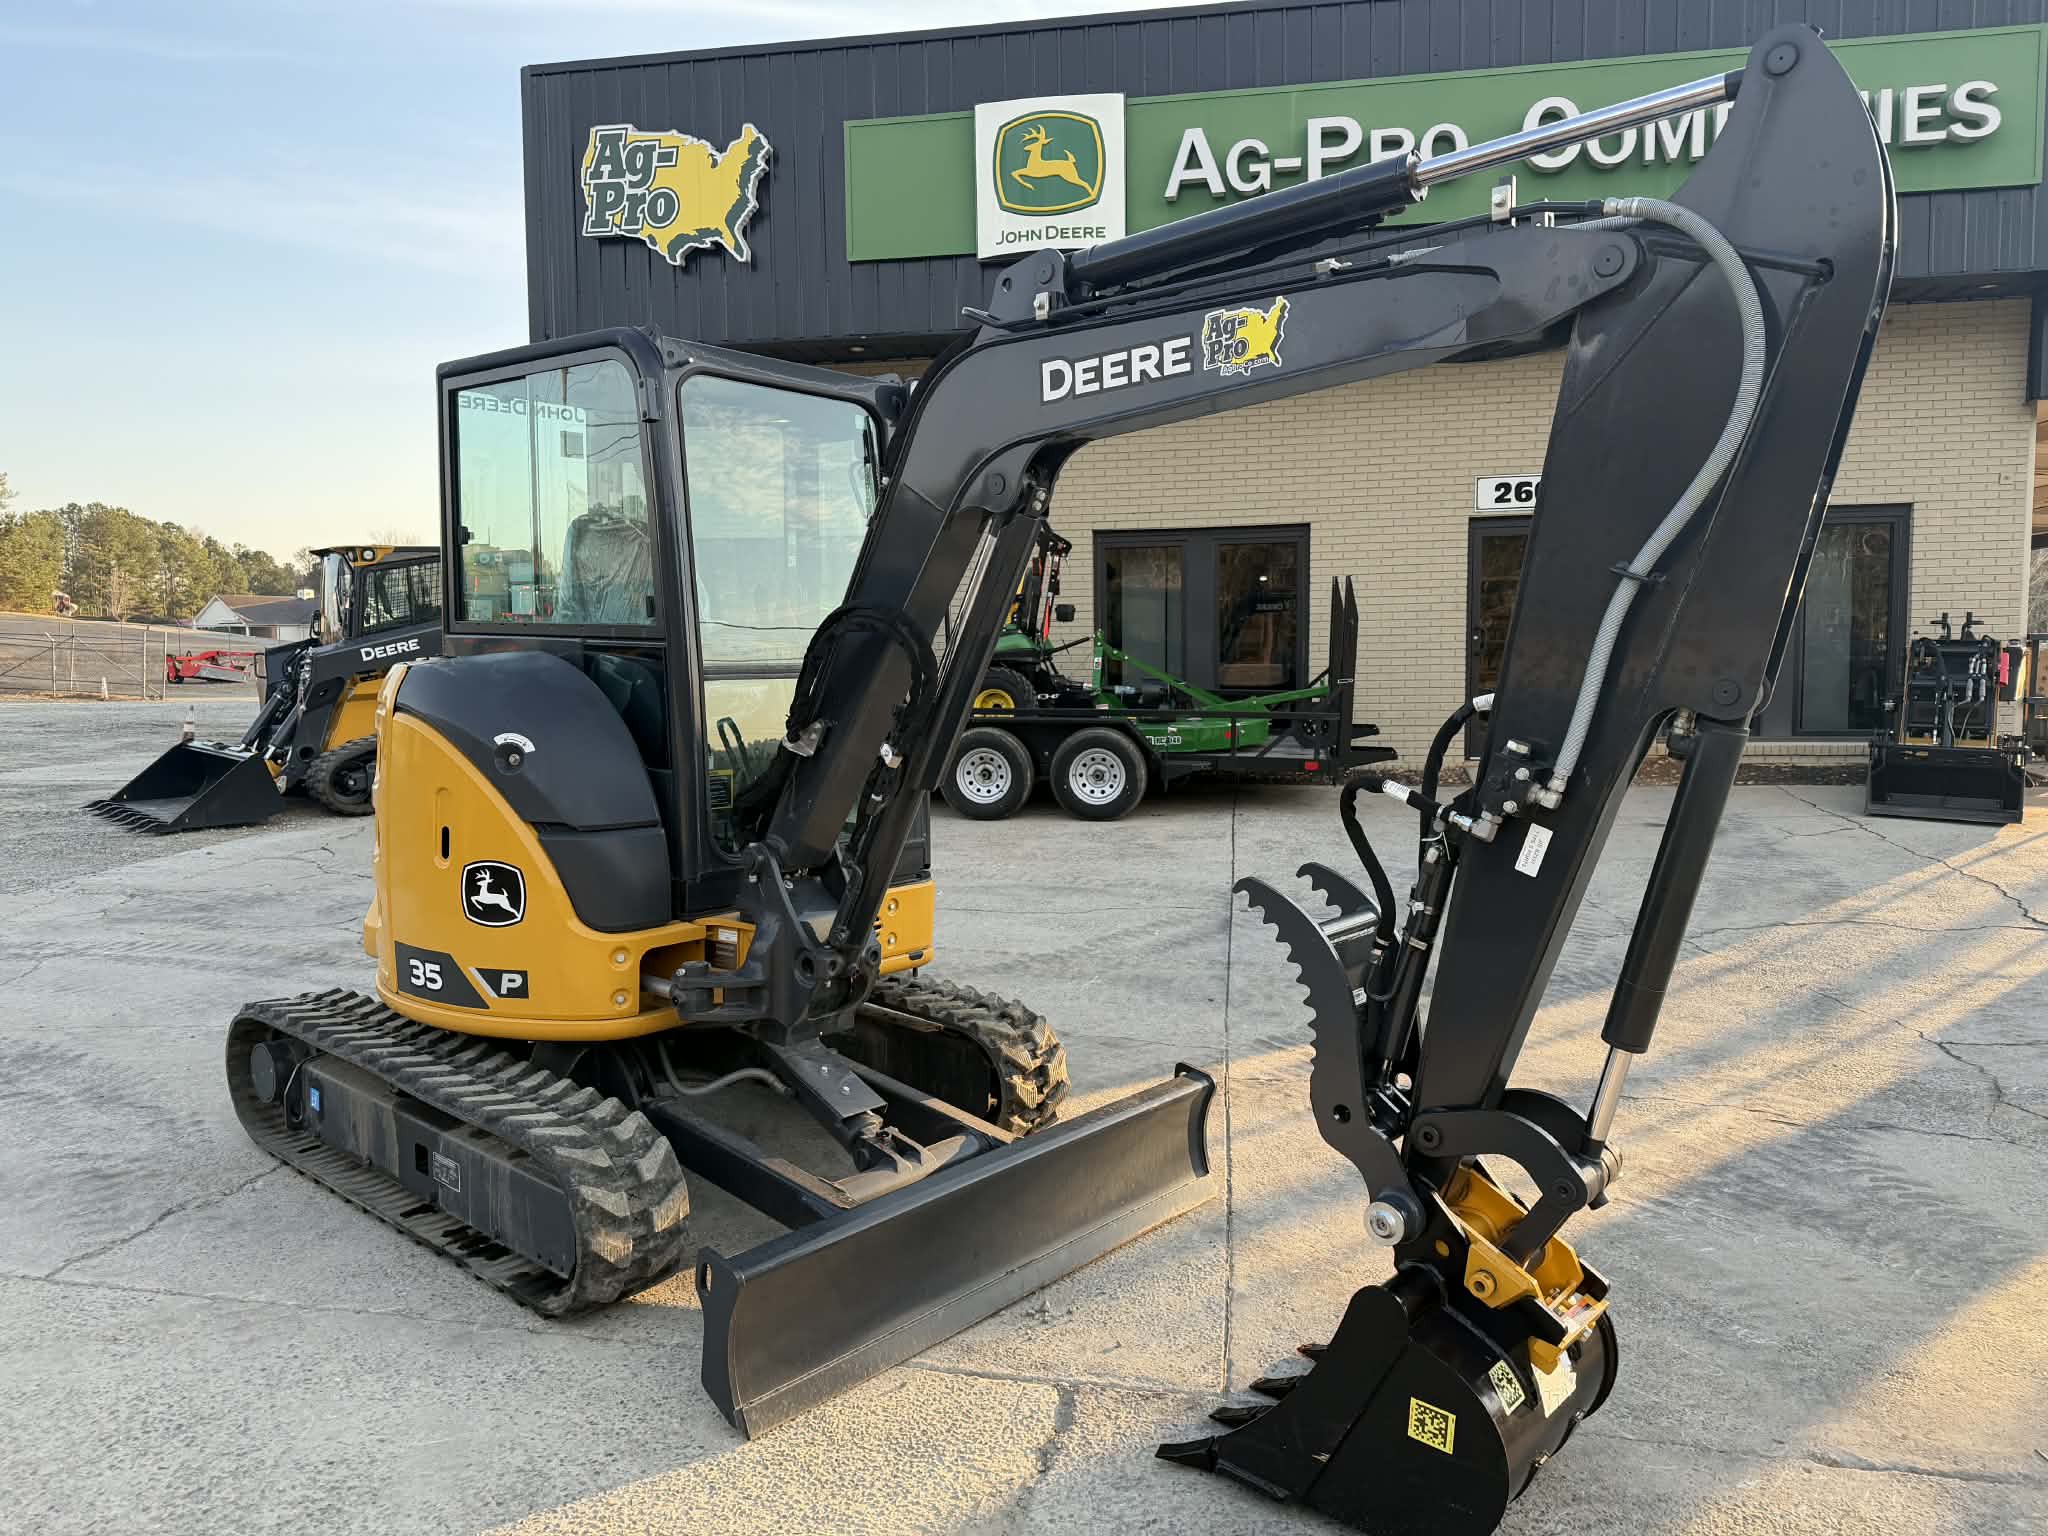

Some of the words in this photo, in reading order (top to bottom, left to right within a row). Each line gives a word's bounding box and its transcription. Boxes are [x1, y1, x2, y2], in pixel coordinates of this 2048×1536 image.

[585, 130, 678, 190] Ag-
[586, 181, 679, 233] Pro
[996, 229, 1042, 245] JOHN
[1045, 225, 1106, 241] DEERE
[1206, 313, 1248, 342] Ag-
[1207, 338, 1250, 366] Pro
[1041, 336, 1192, 403] DEERE
[1494, 481, 1541, 504] 26
[360, 638, 421, 662] DEERE
[409, 959, 443, 991] 35
[500, 972, 523, 995] P
